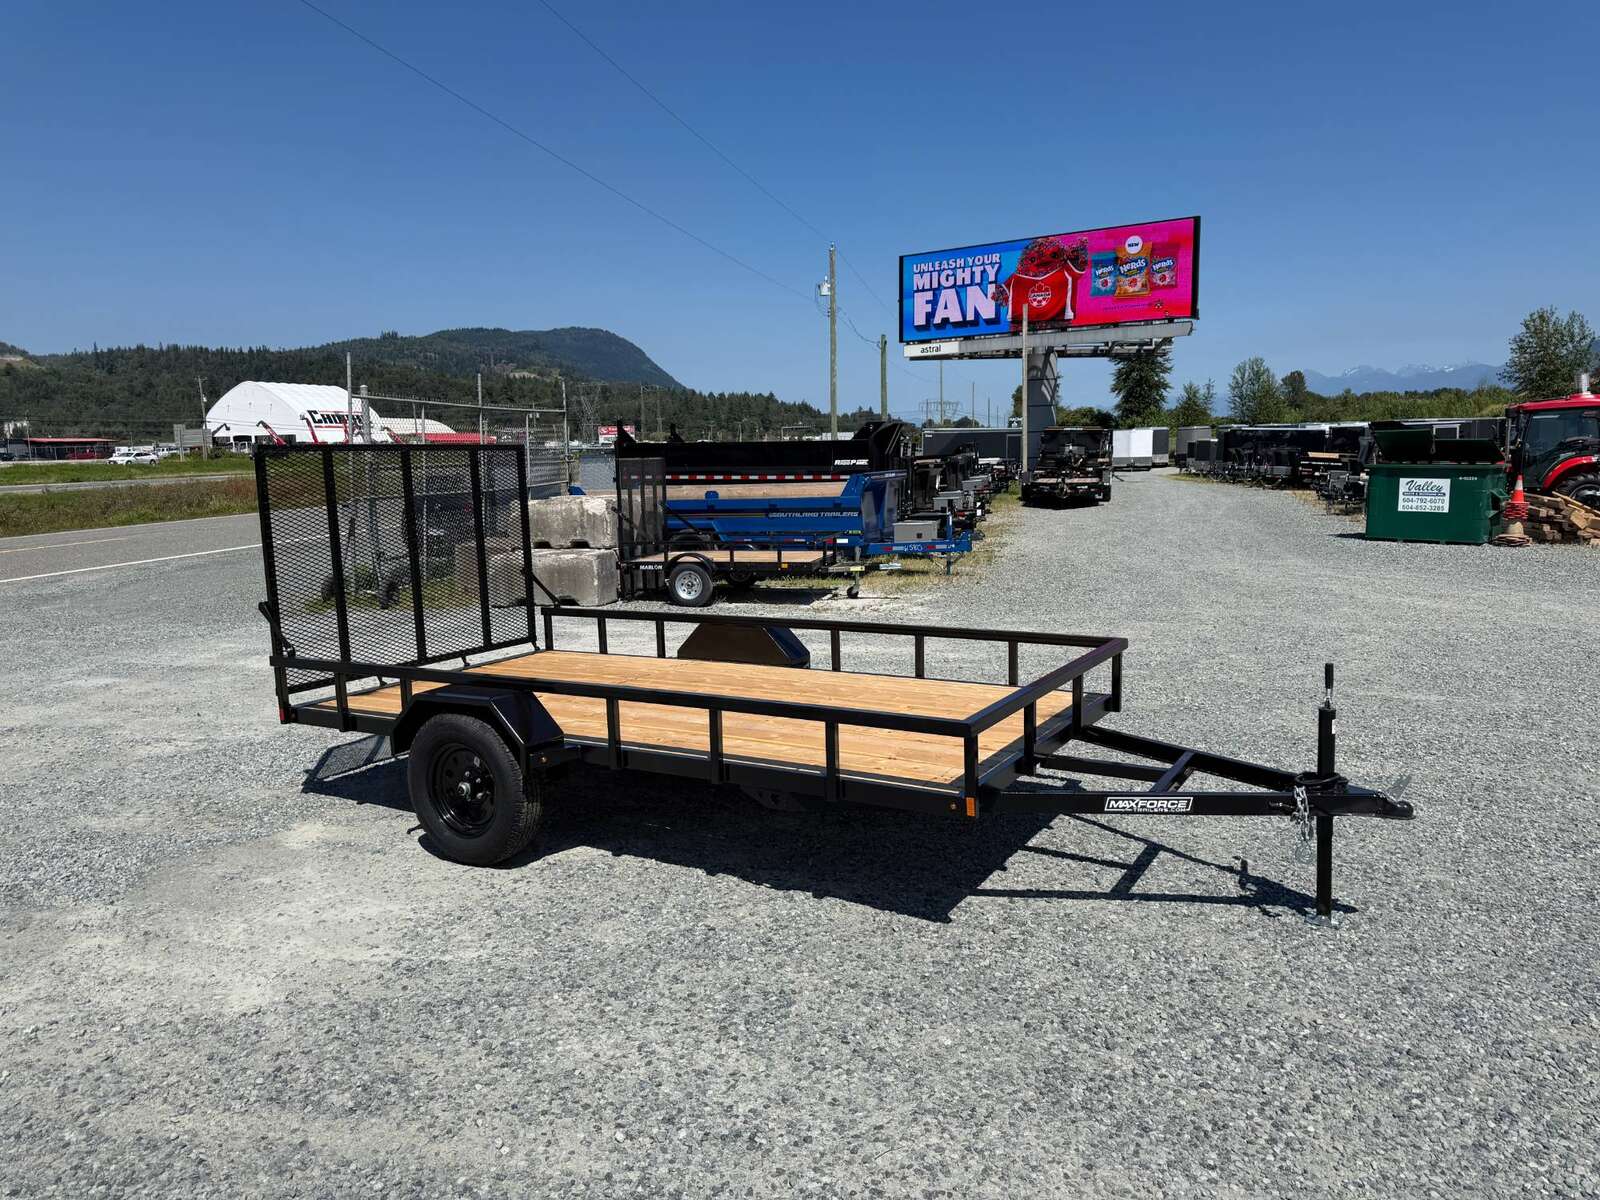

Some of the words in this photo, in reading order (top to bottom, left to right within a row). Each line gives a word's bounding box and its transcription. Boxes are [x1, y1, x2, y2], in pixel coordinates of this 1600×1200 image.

[913, 258, 965, 273] UNLEASH
[967, 253, 1001, 266] YOUR
[913, 264, 1000, 291] MIGHTY
[913, 284, 996, 326] FAN
[920, 344, 942, 354] astral
[1406, 479, 1444, 493] Valley
[1108, 799, 1189, 809] MAXFORCE
